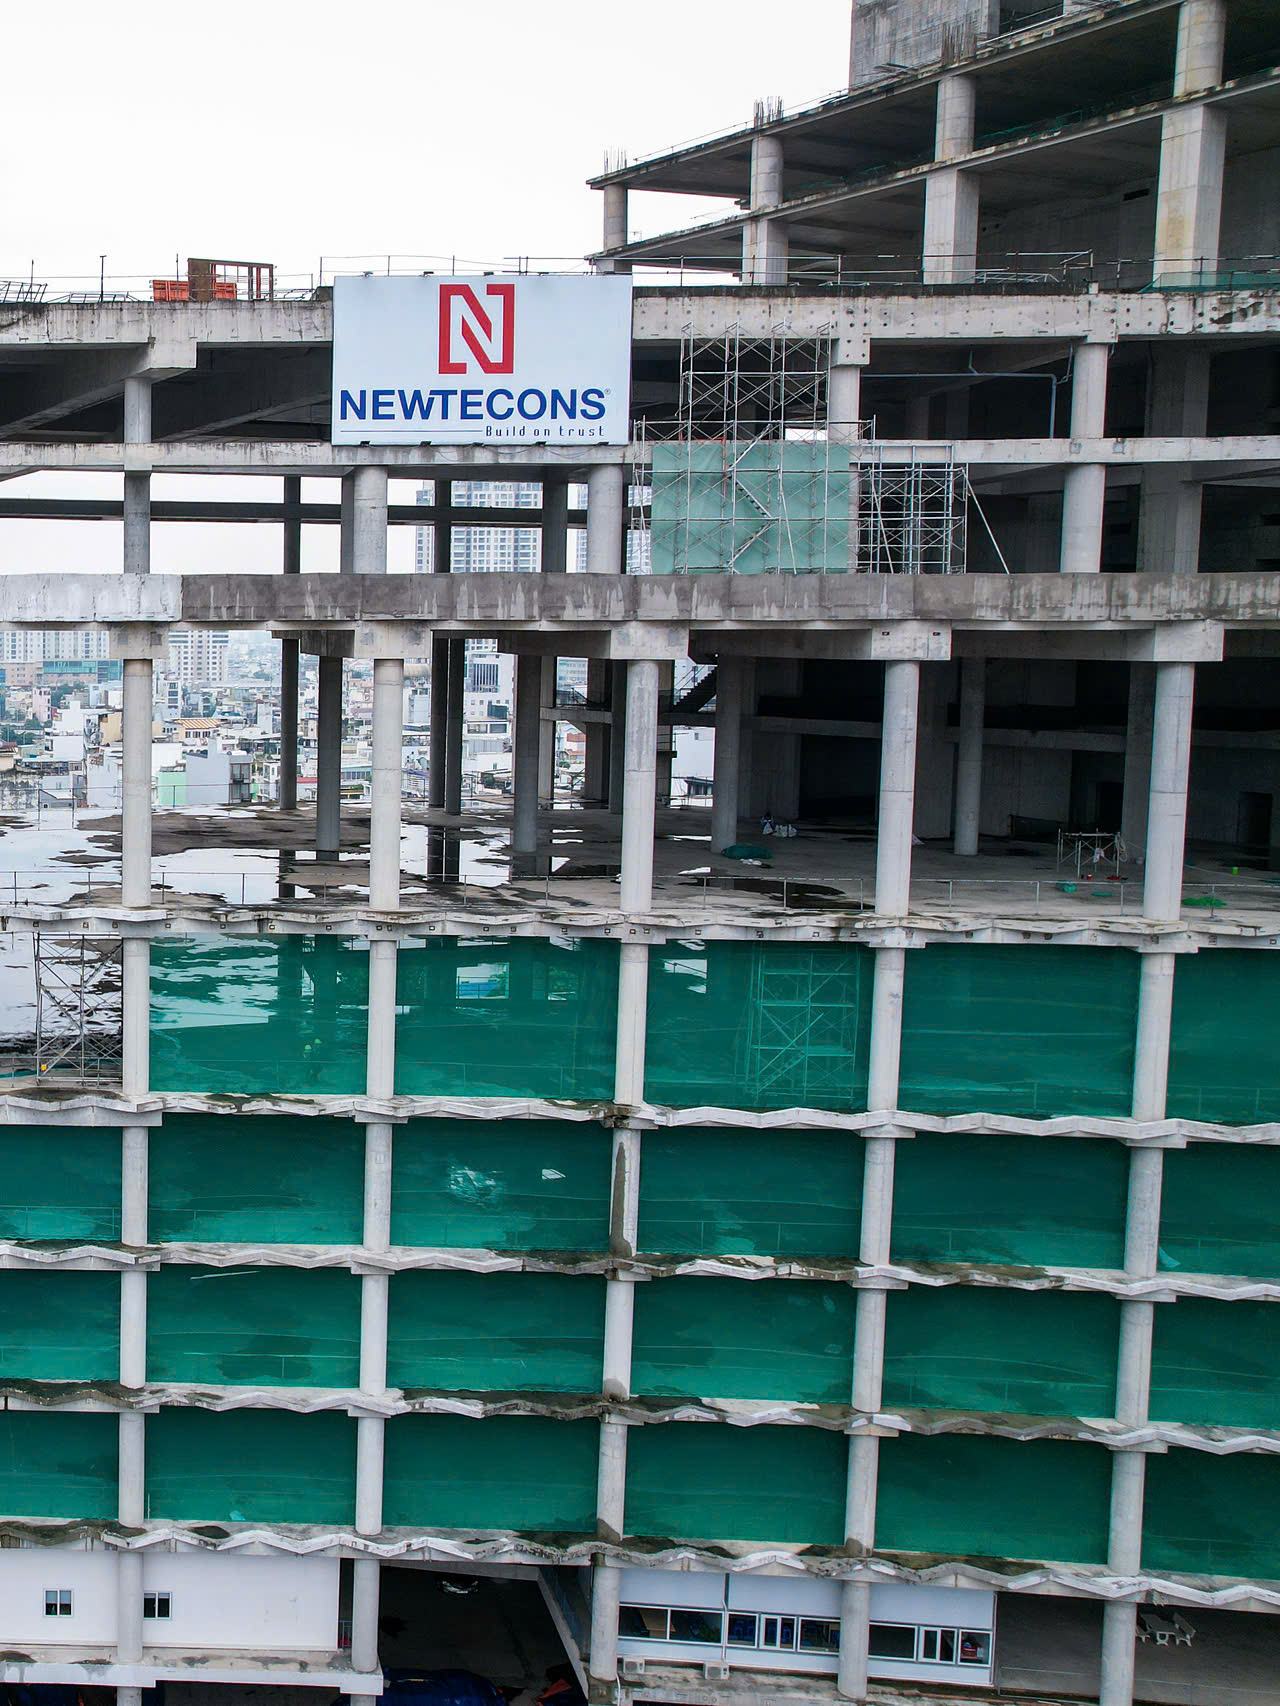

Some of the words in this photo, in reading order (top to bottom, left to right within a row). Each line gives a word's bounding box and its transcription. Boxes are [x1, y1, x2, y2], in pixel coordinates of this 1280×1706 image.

[438, 284, 515, 374] N
[340, 388, 606, 420] NEWTECONS
[485, 425, 526, 437] Build
[533, 428, 551, 437] on
[559, 425, 605, 437] trust
